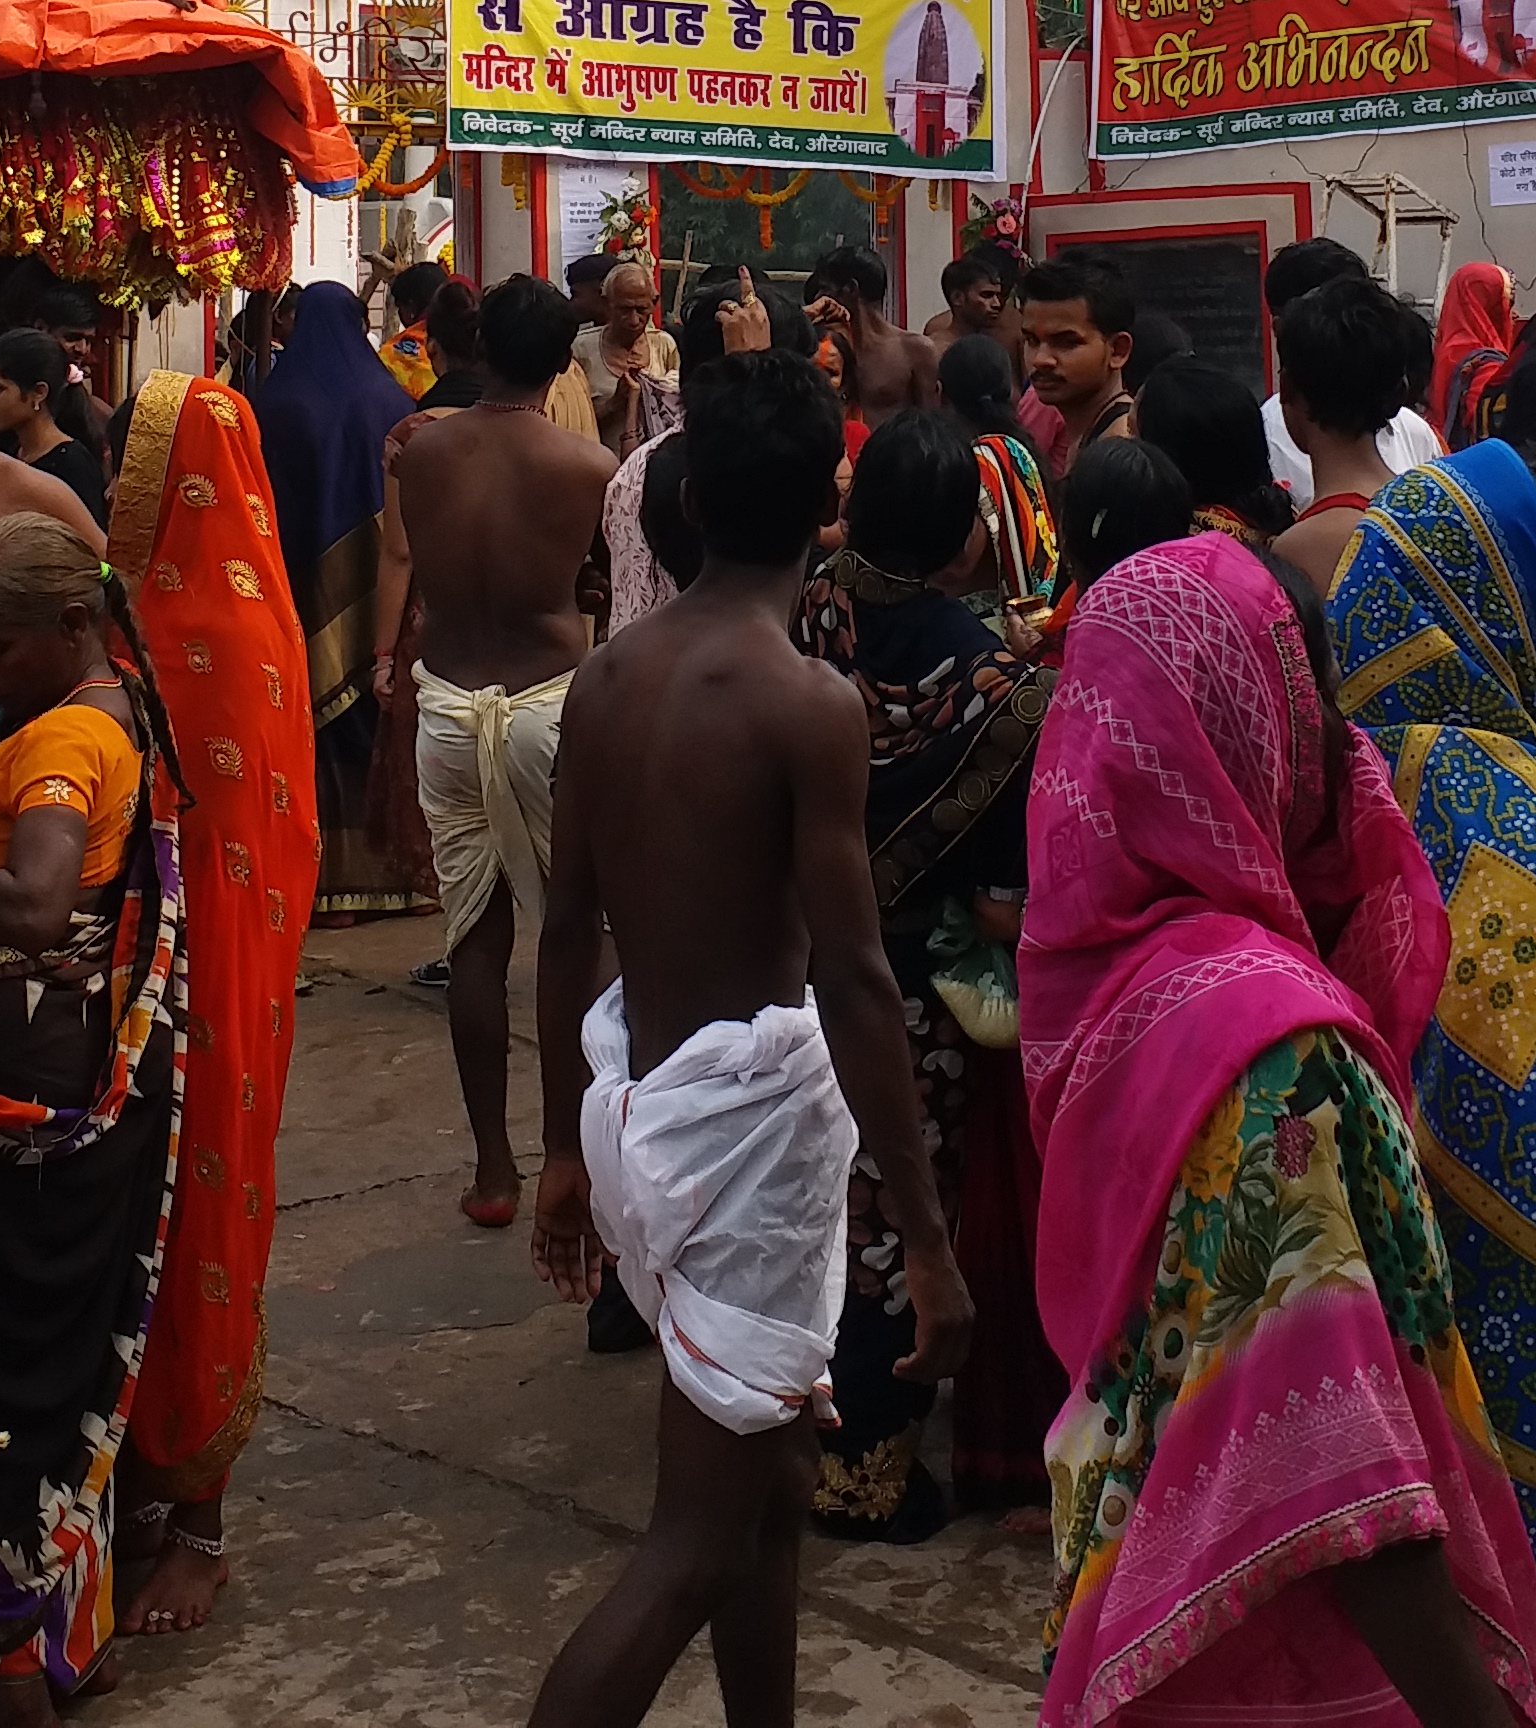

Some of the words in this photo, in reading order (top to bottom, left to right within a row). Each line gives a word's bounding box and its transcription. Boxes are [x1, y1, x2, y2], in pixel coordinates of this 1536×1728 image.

[787, 0, 860, 56] कि
[463, 44, 535, 92] मन्दिर
[545, 49, 571, 95] में
[687, 69, 772, 107] पहनकर
[781, 76, 800, 109] न
[1113, 29, 1227, 111] हार्दिक
[1237, 14, 1433, 92] अभिनन्दन
[550, 118, 585, 143] सूर्य
[590, 120, 647, 141] मन्दिर
[651, 128, 695, 144] न्यास
[1197, 117, 1223, 143] सूर्य
[1230, 113, 1285, 133] मन्दिर
[1288, 109, 1334, 125] न्यास
